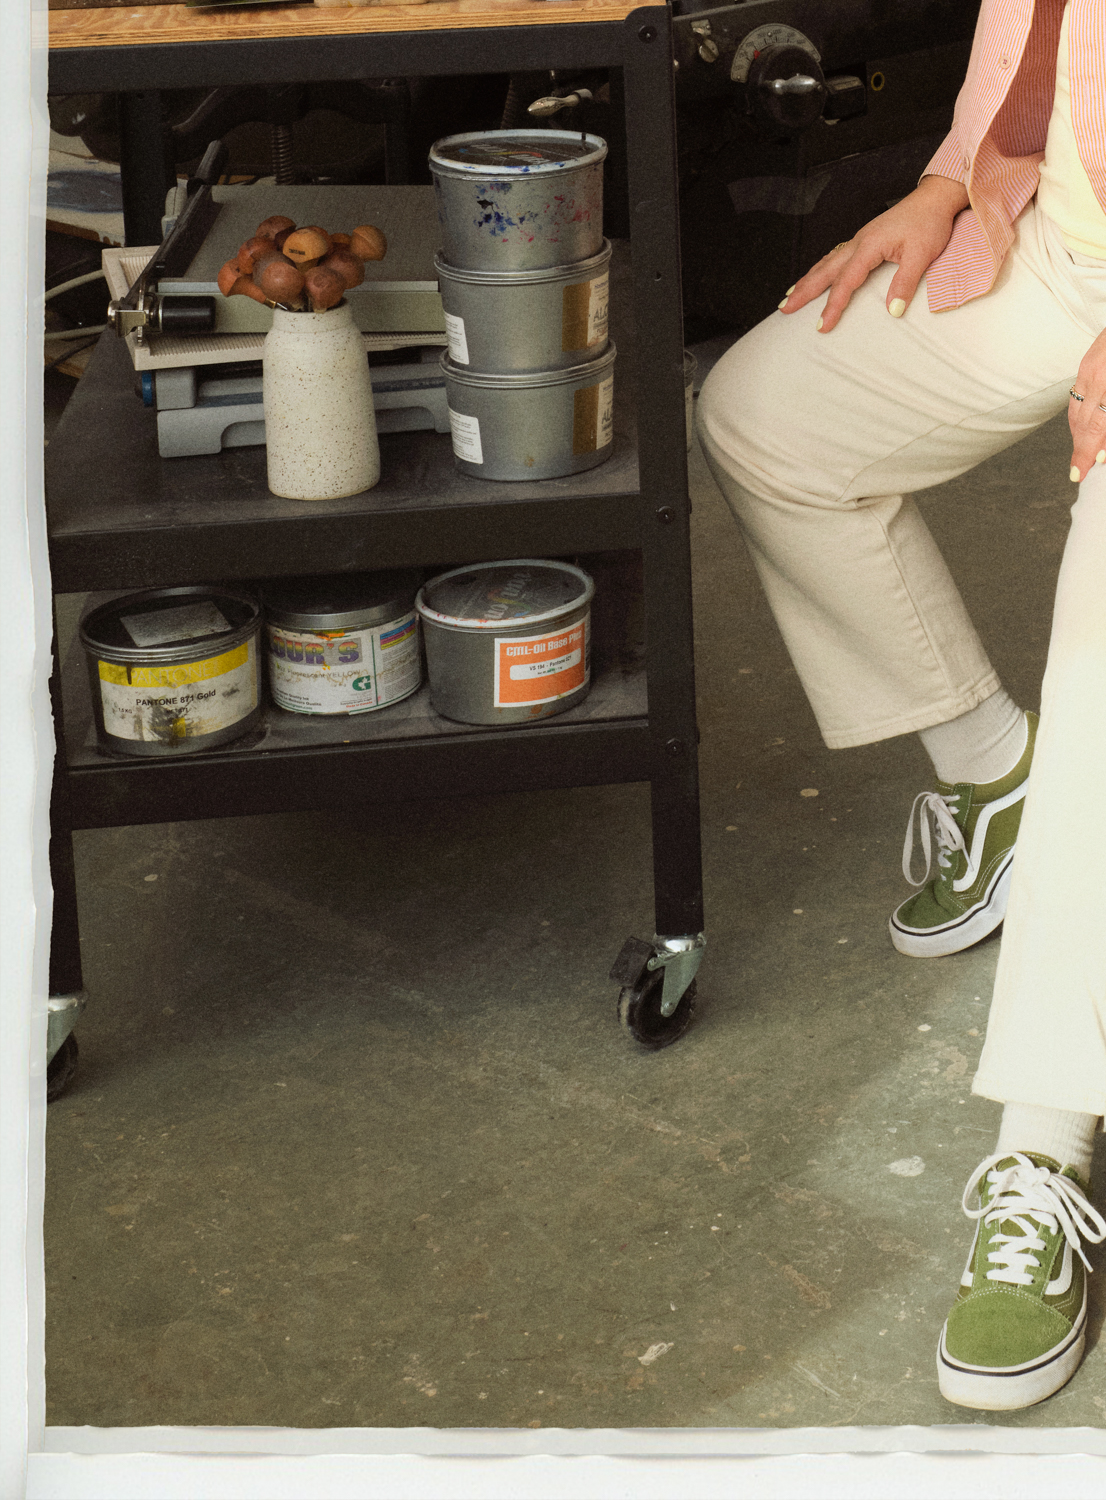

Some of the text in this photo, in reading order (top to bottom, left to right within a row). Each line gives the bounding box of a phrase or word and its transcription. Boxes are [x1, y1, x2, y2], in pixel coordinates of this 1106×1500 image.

[547, 637, 568, 651] Base
[135, 689, 216, 706] PANTONE 871 Gold
